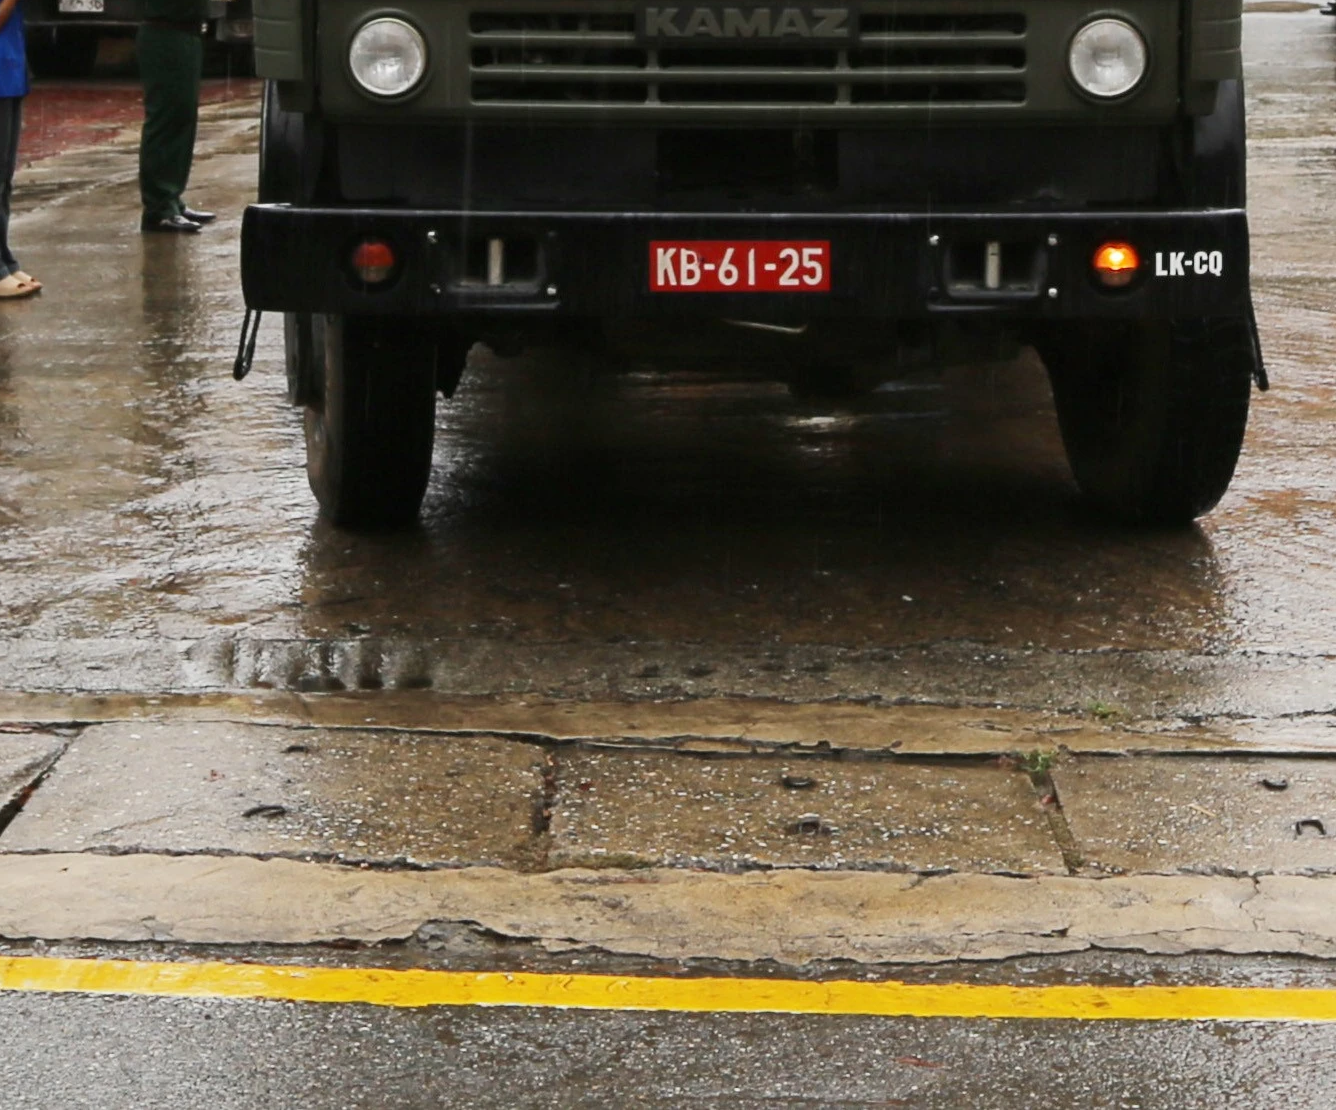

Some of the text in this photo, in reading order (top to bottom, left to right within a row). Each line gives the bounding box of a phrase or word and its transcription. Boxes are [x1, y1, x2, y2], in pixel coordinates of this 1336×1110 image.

[644, 7, 849, 38] KAMAZ
[655, 247, 824, 287] KB-61-25
[1154, 250, 1224, 278] LK-CQ
